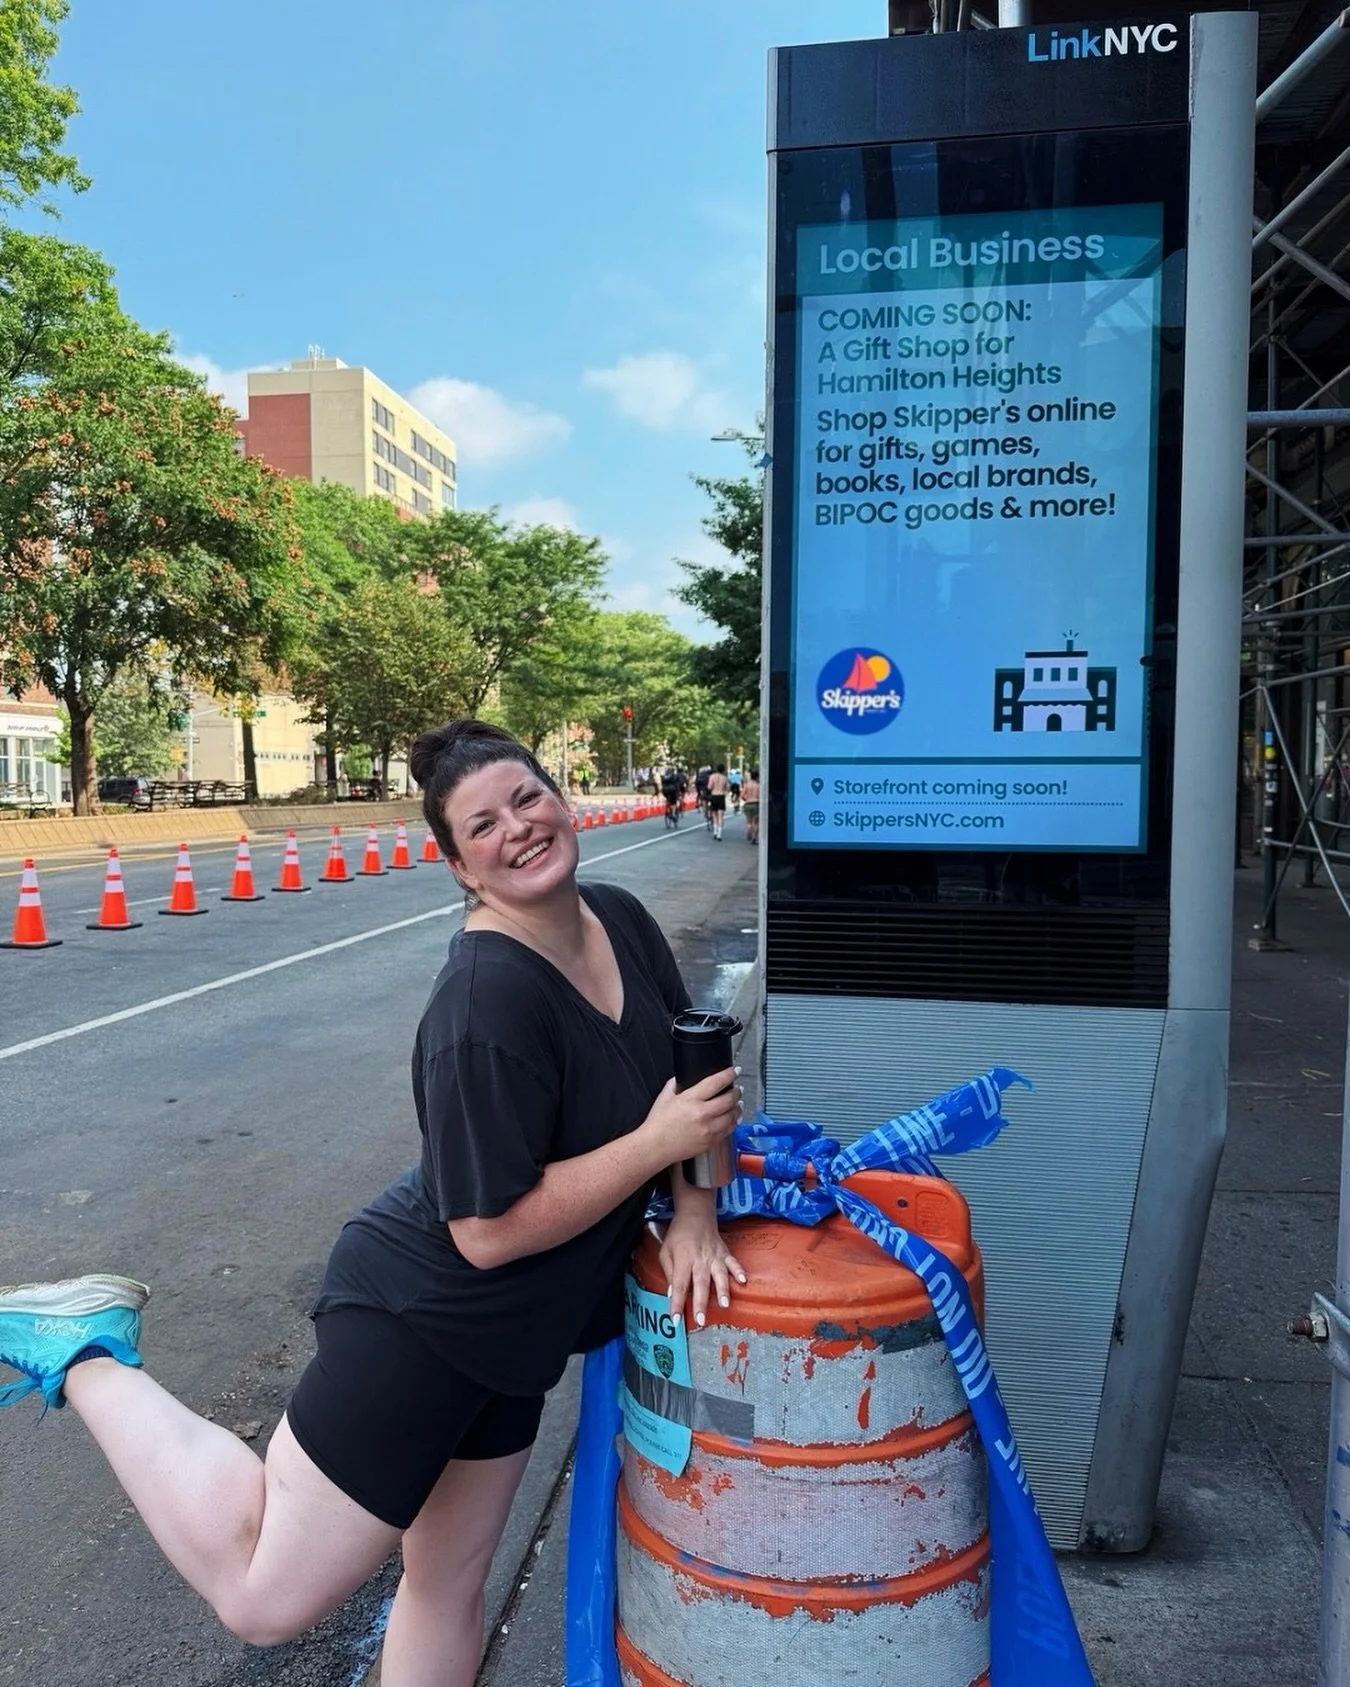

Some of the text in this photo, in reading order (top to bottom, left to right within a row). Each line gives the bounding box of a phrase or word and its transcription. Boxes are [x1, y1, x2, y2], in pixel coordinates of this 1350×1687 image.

[1028, 23, 1178, 62] LinkNYC
[819, 231, 1105, 274] Local Business
[818, 299, 1031, 331] COMING SOON:
[817, 331, 1015, 364] A Gift Shop for
[817, 362, 1062, 394] Hamilton Heights
[817, 396, 1116, 436] Shop Skipper's online
[816, 436, 1040, 469] for gifts, games,
[816, 461, 1097, 495] books, local brands,
[815, 492, 1116, 530] BIPOC goods & more!
[822, 688, 900, 716] Skipper's
[834, 779, 1068, 800] Storefront coming soon!
[833, 811, 1005, 831] SkippersNYC.com
